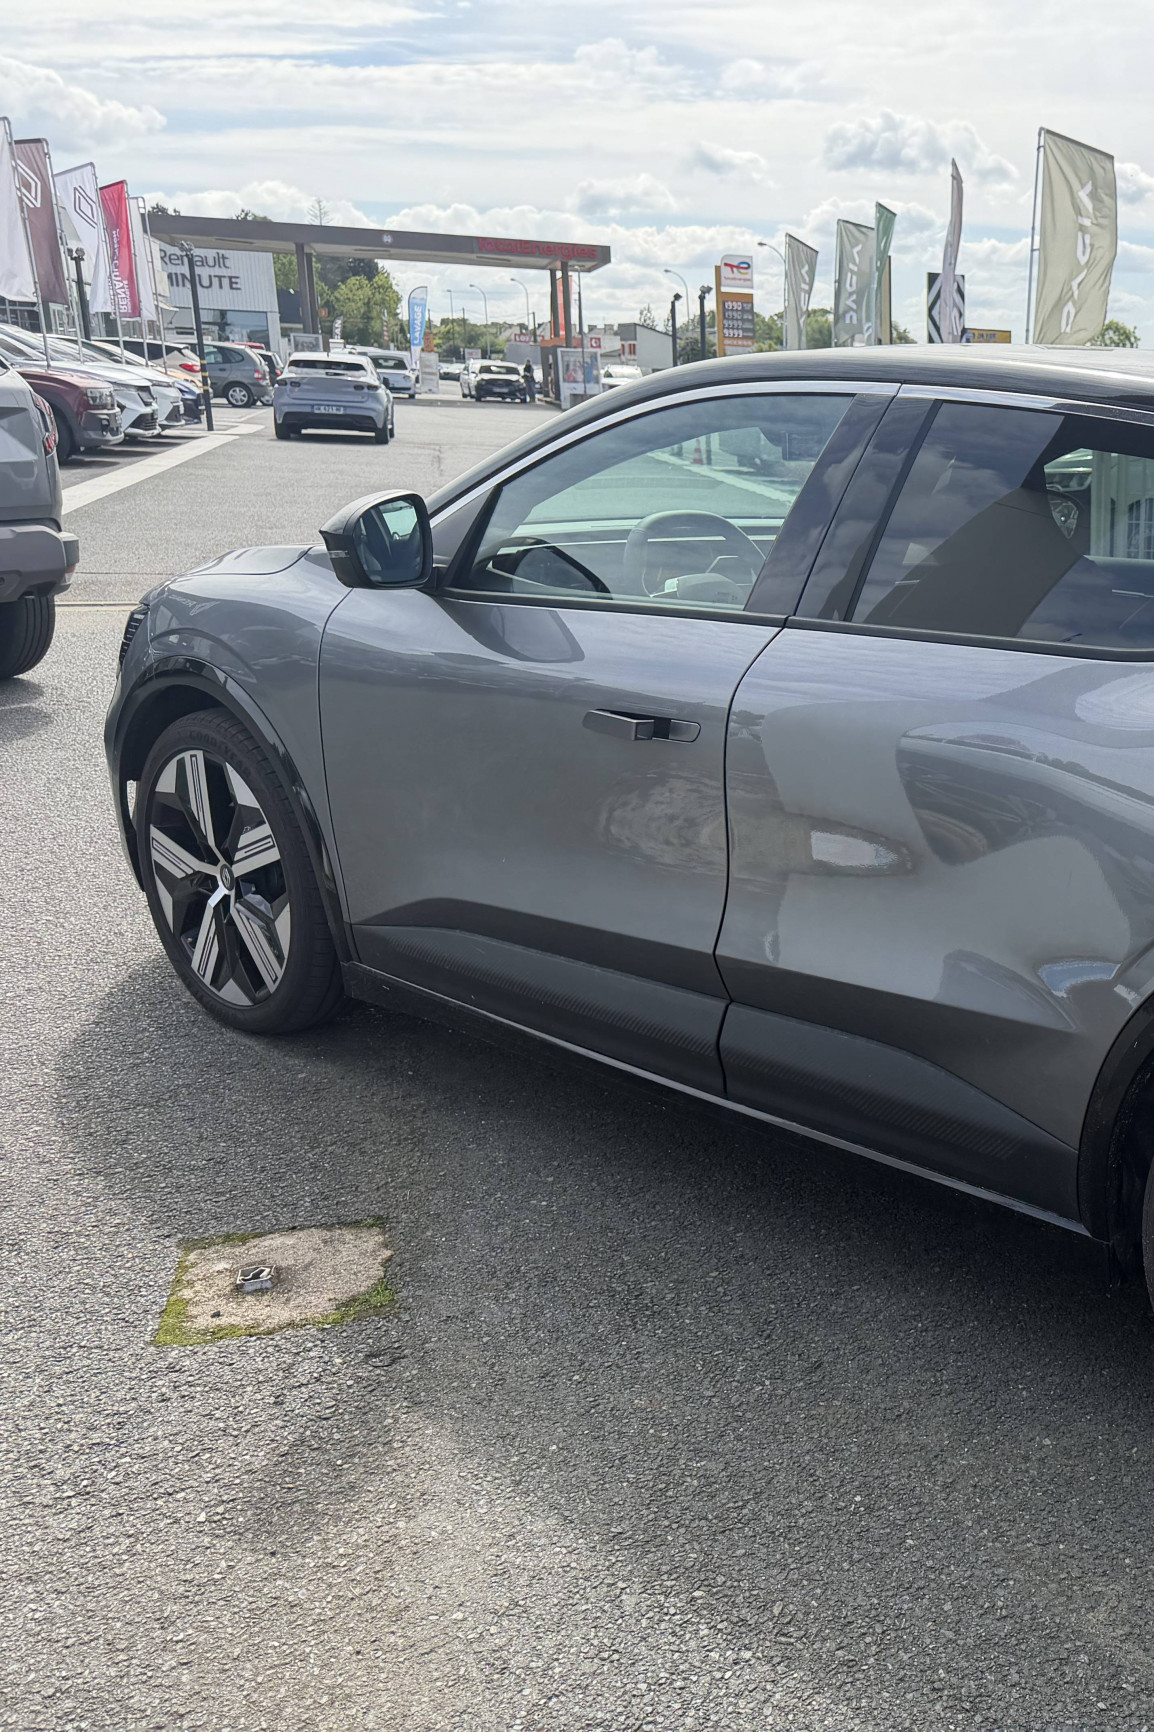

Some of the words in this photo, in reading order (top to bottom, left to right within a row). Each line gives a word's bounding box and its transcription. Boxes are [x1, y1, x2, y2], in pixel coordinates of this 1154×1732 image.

[477, 237, 599, 261] TotalEnergies
[1060, 180, 1094, 333] DACIA
[844, 243, 863, 325] DACIA
[413, 305, 423, 344] LAVAGE
